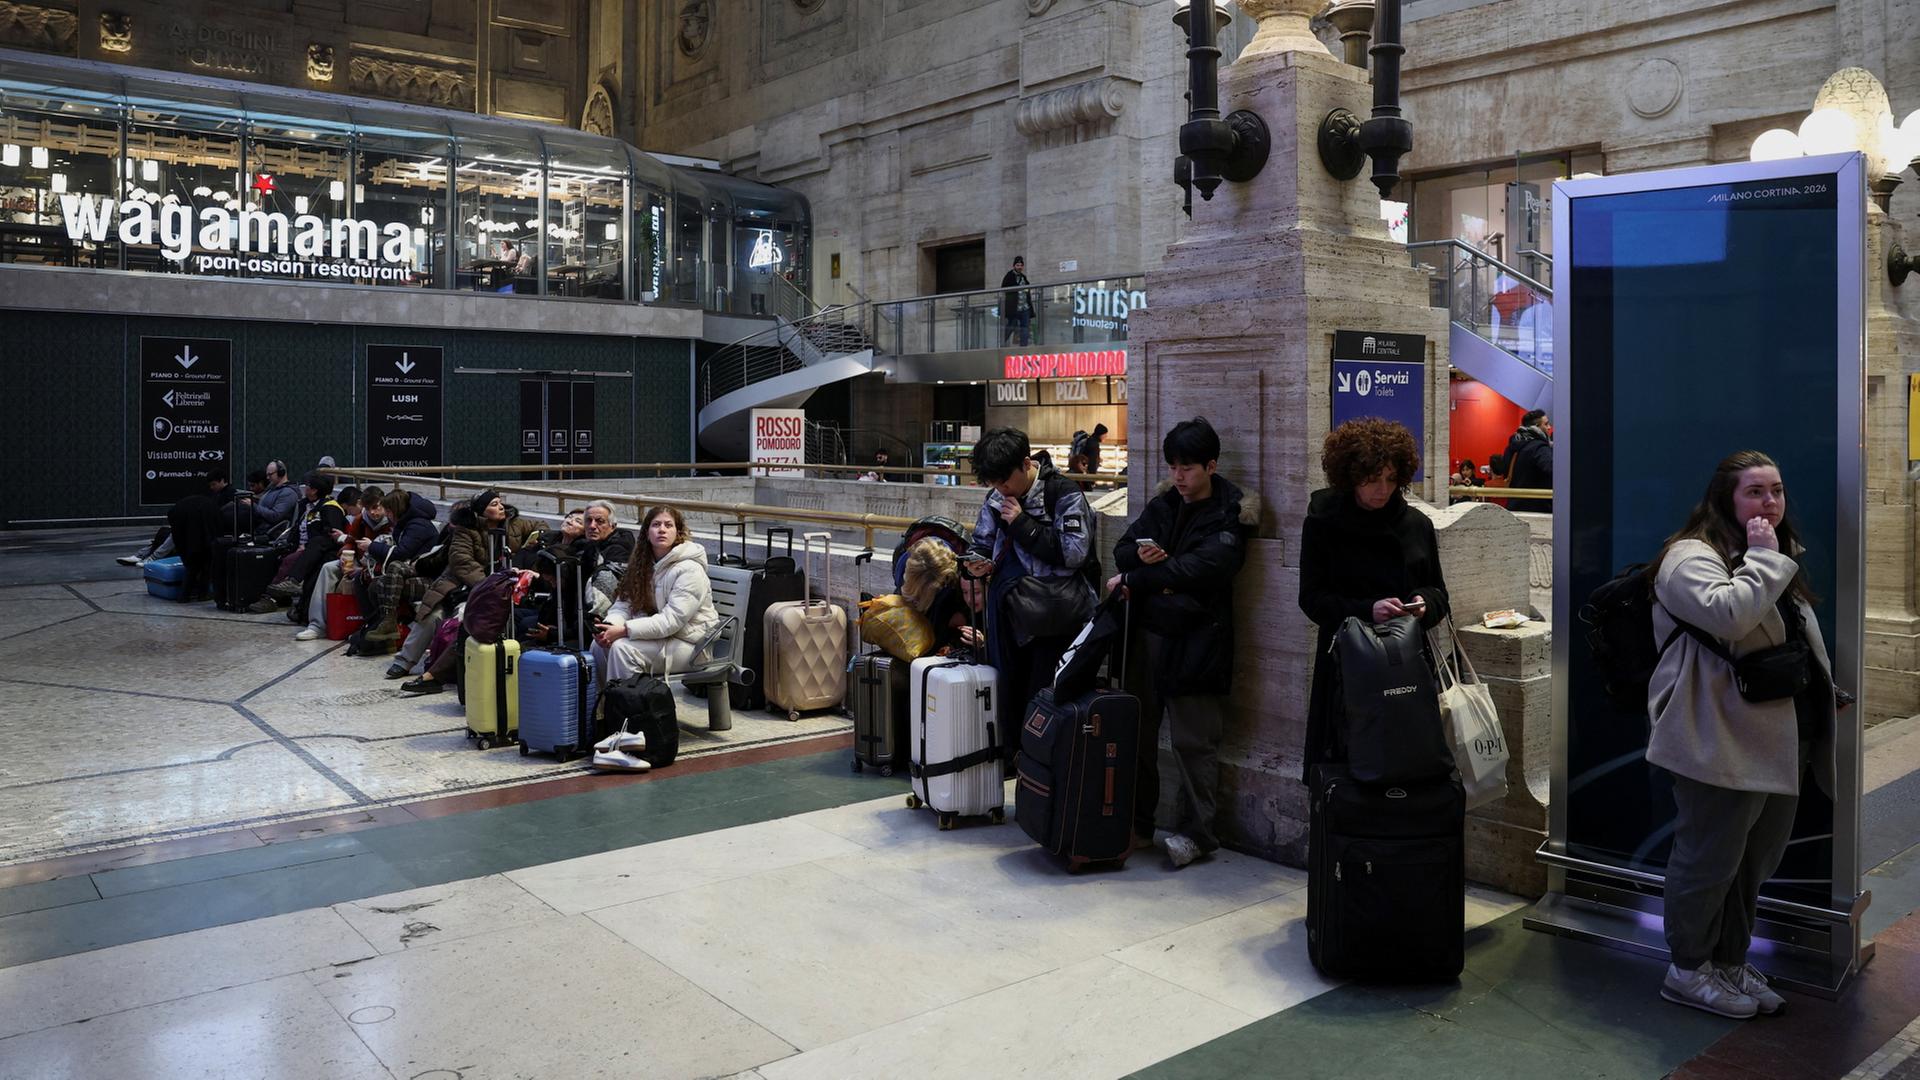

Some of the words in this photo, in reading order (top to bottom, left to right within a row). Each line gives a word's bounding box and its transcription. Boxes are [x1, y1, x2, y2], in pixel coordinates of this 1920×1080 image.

[1707, 191, 1753, 203] MILANO
[1753, 187, 1801, 199] CORTINA
[1803, 184, 1828, 194] 2026
[59, 194, 412, 262] wagamama
[200, 255, 305, 274] pan-asian
[310, 262, 412, 280] restaurant
[1004, 350, 1127, 379] ROSSOPOMODORO
[1375, 370, 1409, 384] Servizi
[175, 391, 211, 400] Feltrinelli
[997, 383, 1027, 401] DOLCI
[1056, 381, 1089, 401] PIZZA
[1375, 385, 1394, 397] Toilets
[175, 399, 205, 407] Librerie
[391, 394, 418, 403] LUSH
[174, 425, 220, 434] CENTRALE
[756, 416, 801, 437] ROSSO
[381, 436, 429, 447] yamamay
[756, 438, 801, 450] POMODORO
[1383, 685, 1418, 697] FREDDY
